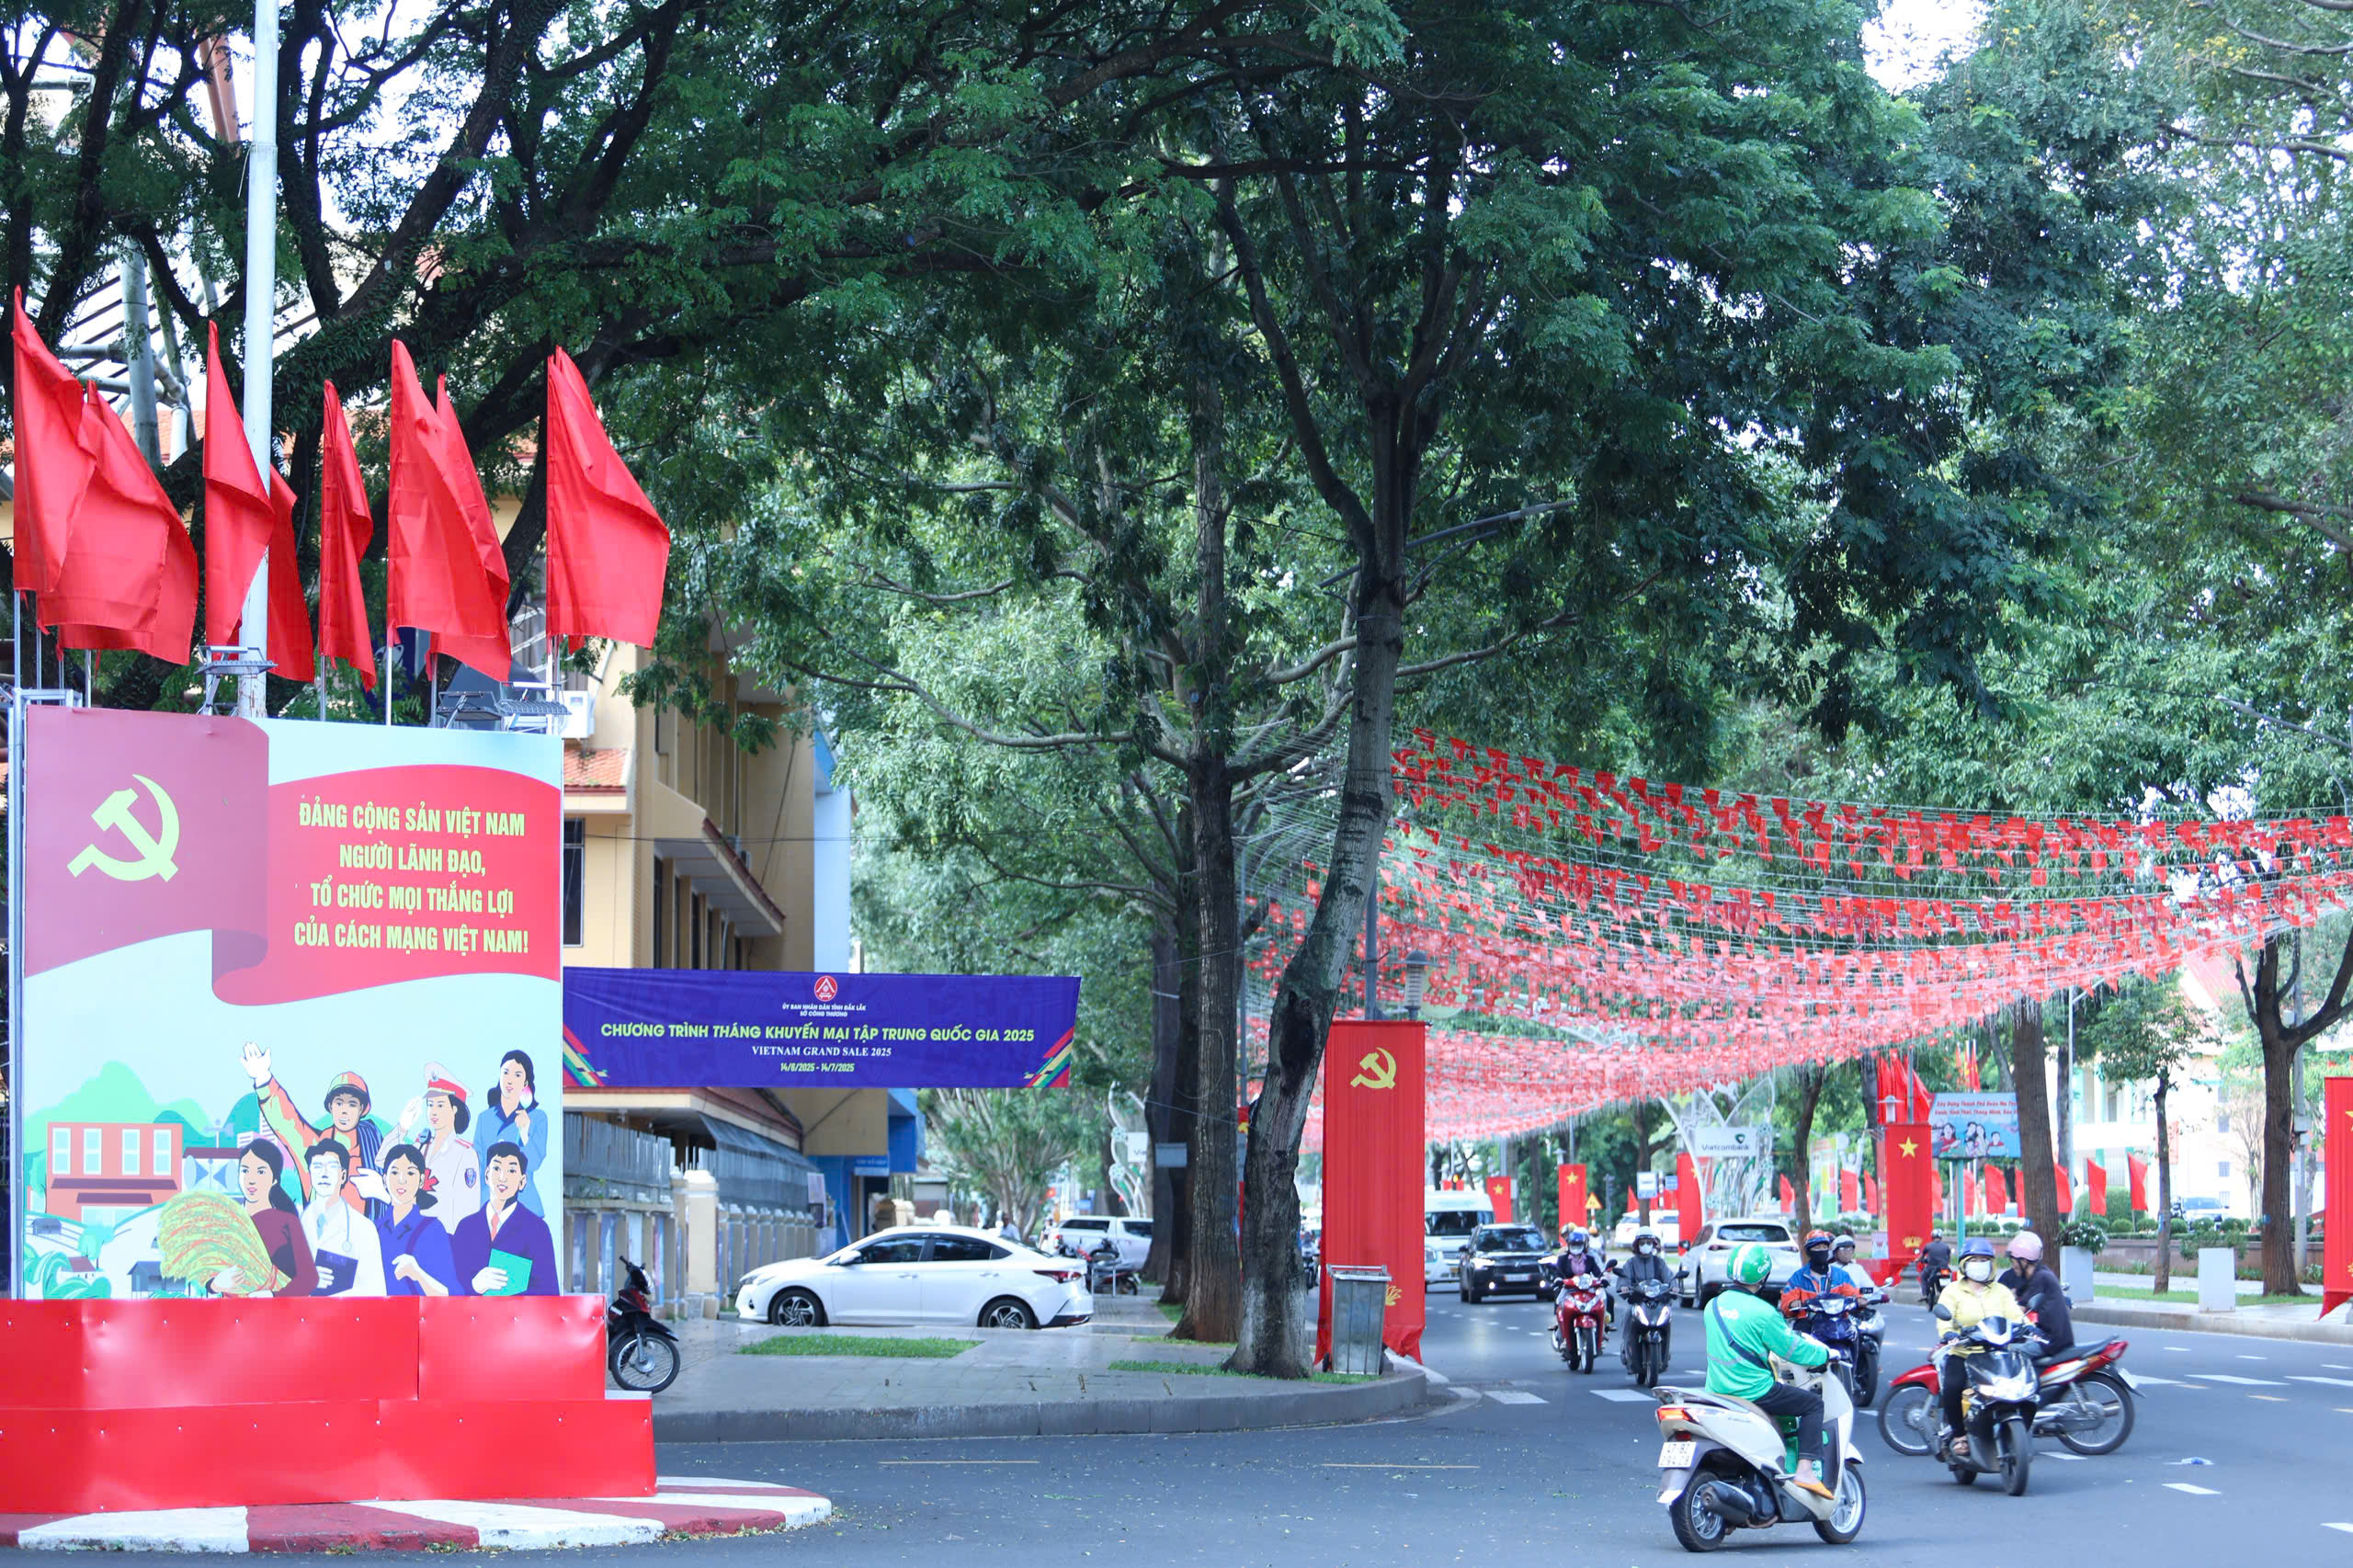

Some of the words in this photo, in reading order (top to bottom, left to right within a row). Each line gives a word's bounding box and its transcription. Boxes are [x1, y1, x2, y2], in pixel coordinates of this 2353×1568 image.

[299, 796, 347, 827] ĐẢNG
[353, 801, 400, 834] CỘNG
[405, 801, 440, 833] SẢN
[446, 806, 481, 838] VIỆT
[485, 812, 525, 836] NAM
[340, 841, 392, 869] NGƯỜI
[398, 844, 442, 871] LÃNH
[448, 849, 486, 878] ĐẠO,
[311, 875, 333, 907] TỔ
[337, 881, 383, 909] CHỨC
[389, 886, 422, 915] MỌI
[426, 881, 483, 913] THẮNG
[487, 890, 514, 919] LỢI
[294, 915, 330, 947] CỦA
[335, 919, 381, 948] CÁCH
[386, 926, 438, 955] MẠNG
[443, 924, 478, 956] VIỆT
[483, 929, 529, 954] NAM!
[600, 1022, 665, 1038] CHƯƠNG
[668, 1021, 709, 1038] TRÌNH
[712, 1021, 761, 1039] THÁNG
[765, 1022, 819, 1040] KHUYẾN
[823, 1027, 849, 1042] MẠI
[853, 1024, 879, 1043] TẬP
[881, 1028, 926, 1040] TRUNG
[930, 1024, 972, 1041] QUỐC
[974, 1028, 1000, 1041] GIA
[1003, 1028, 1035, 1042] 2025
[752, 1046, 801, 1056] VIETNAM
[802, 1046, 840, 1056] GRAND
[842, 1047, 869, 1057] SALE
[870, 1047, 892, 1057] 2025
[821, 1062, 855, 1073] 14/7/2025
